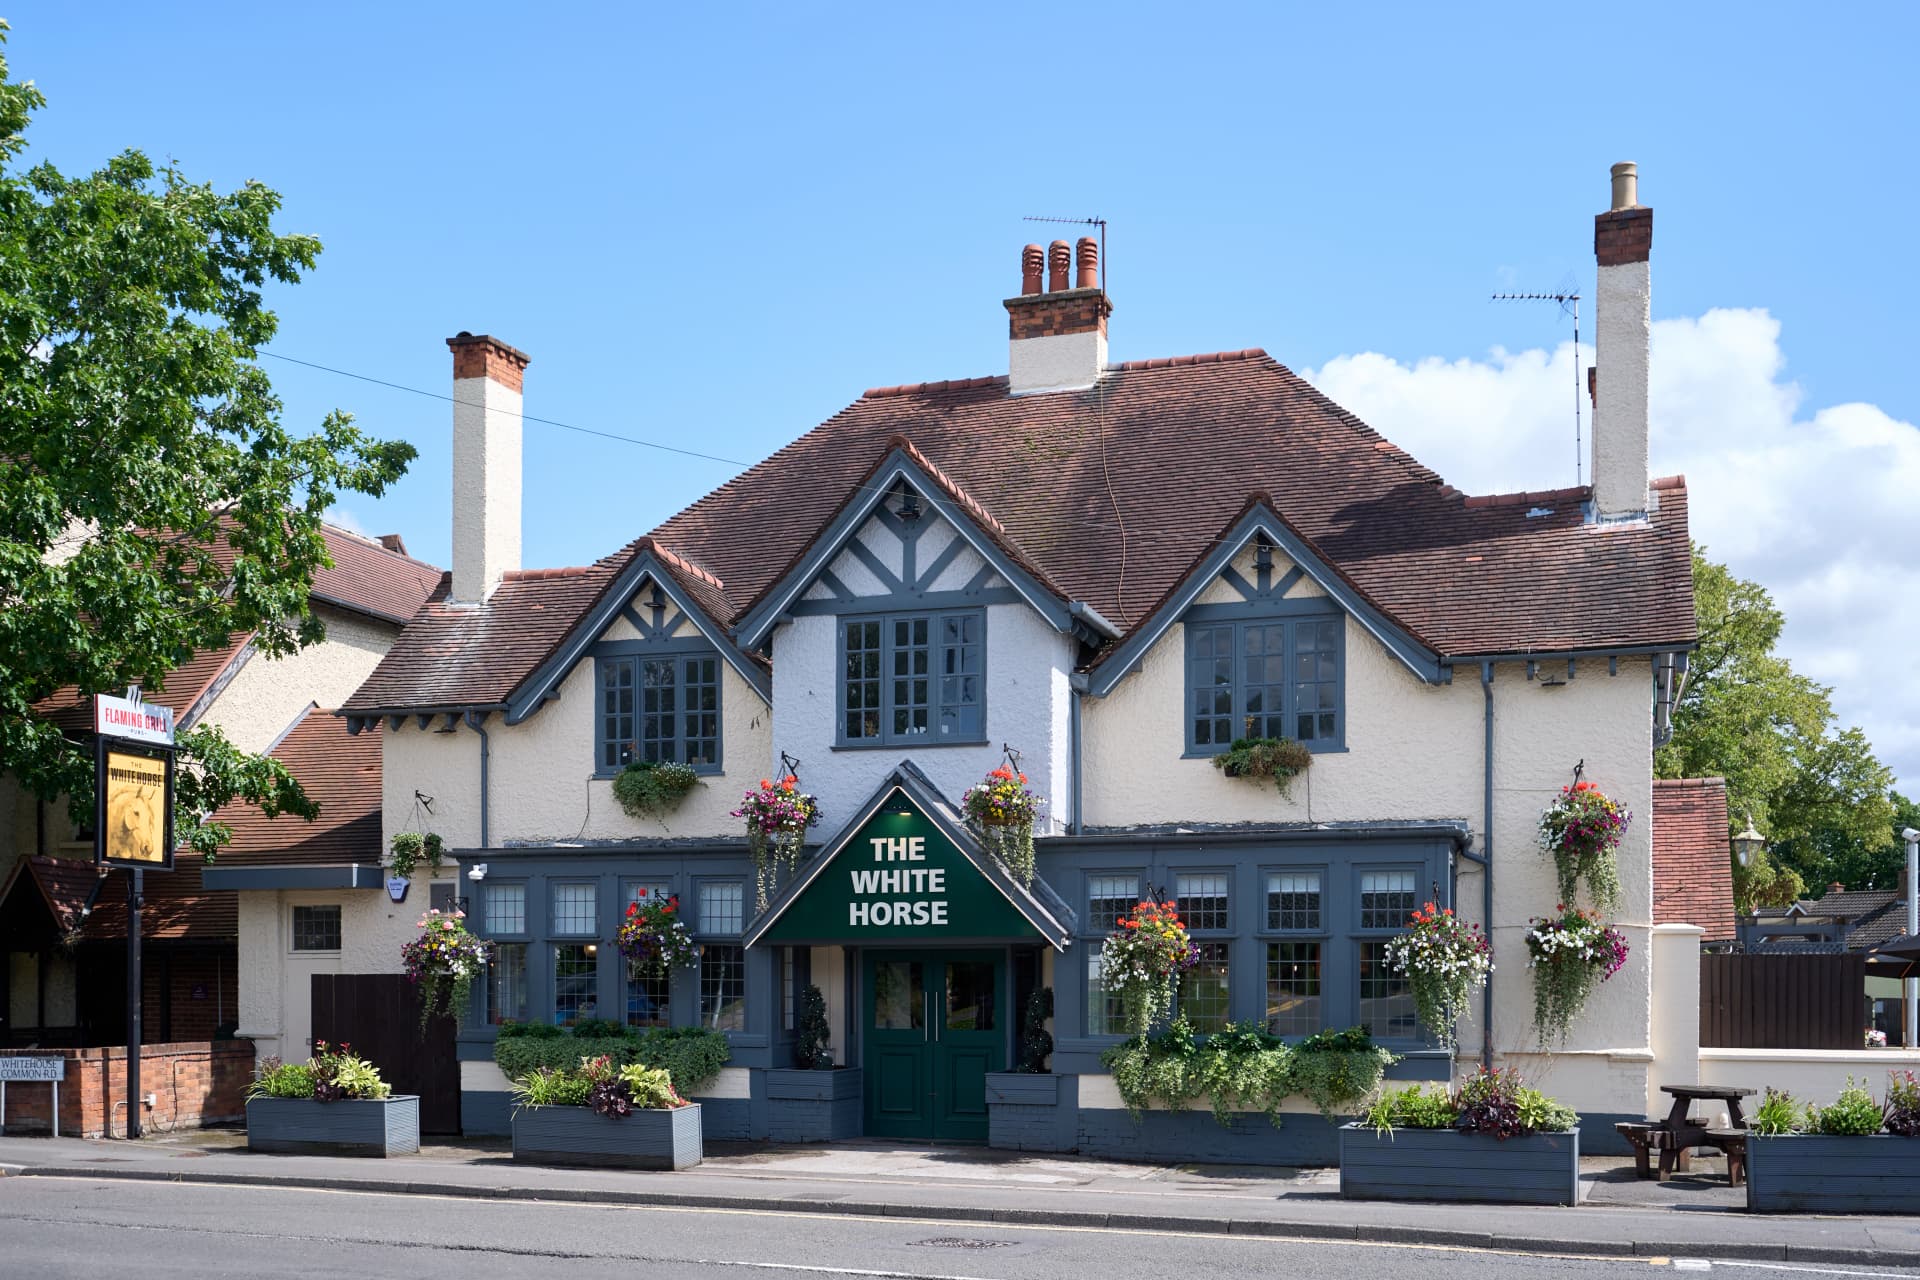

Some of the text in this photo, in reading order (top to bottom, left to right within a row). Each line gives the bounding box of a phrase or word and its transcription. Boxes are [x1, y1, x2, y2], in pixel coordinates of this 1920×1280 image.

[105, 707, 167, 732] FLAMING GRILL
[131, 761, 142, 769] THE
[870, 837, 925, 861] THE
[850, 869, 946, 893] WHITE
[849, 901, 949, 926] HORSE
[1, 1059, 57, 1068] WHITEHOUSE
[1, 1069, 57, 1078] COMMON RD
